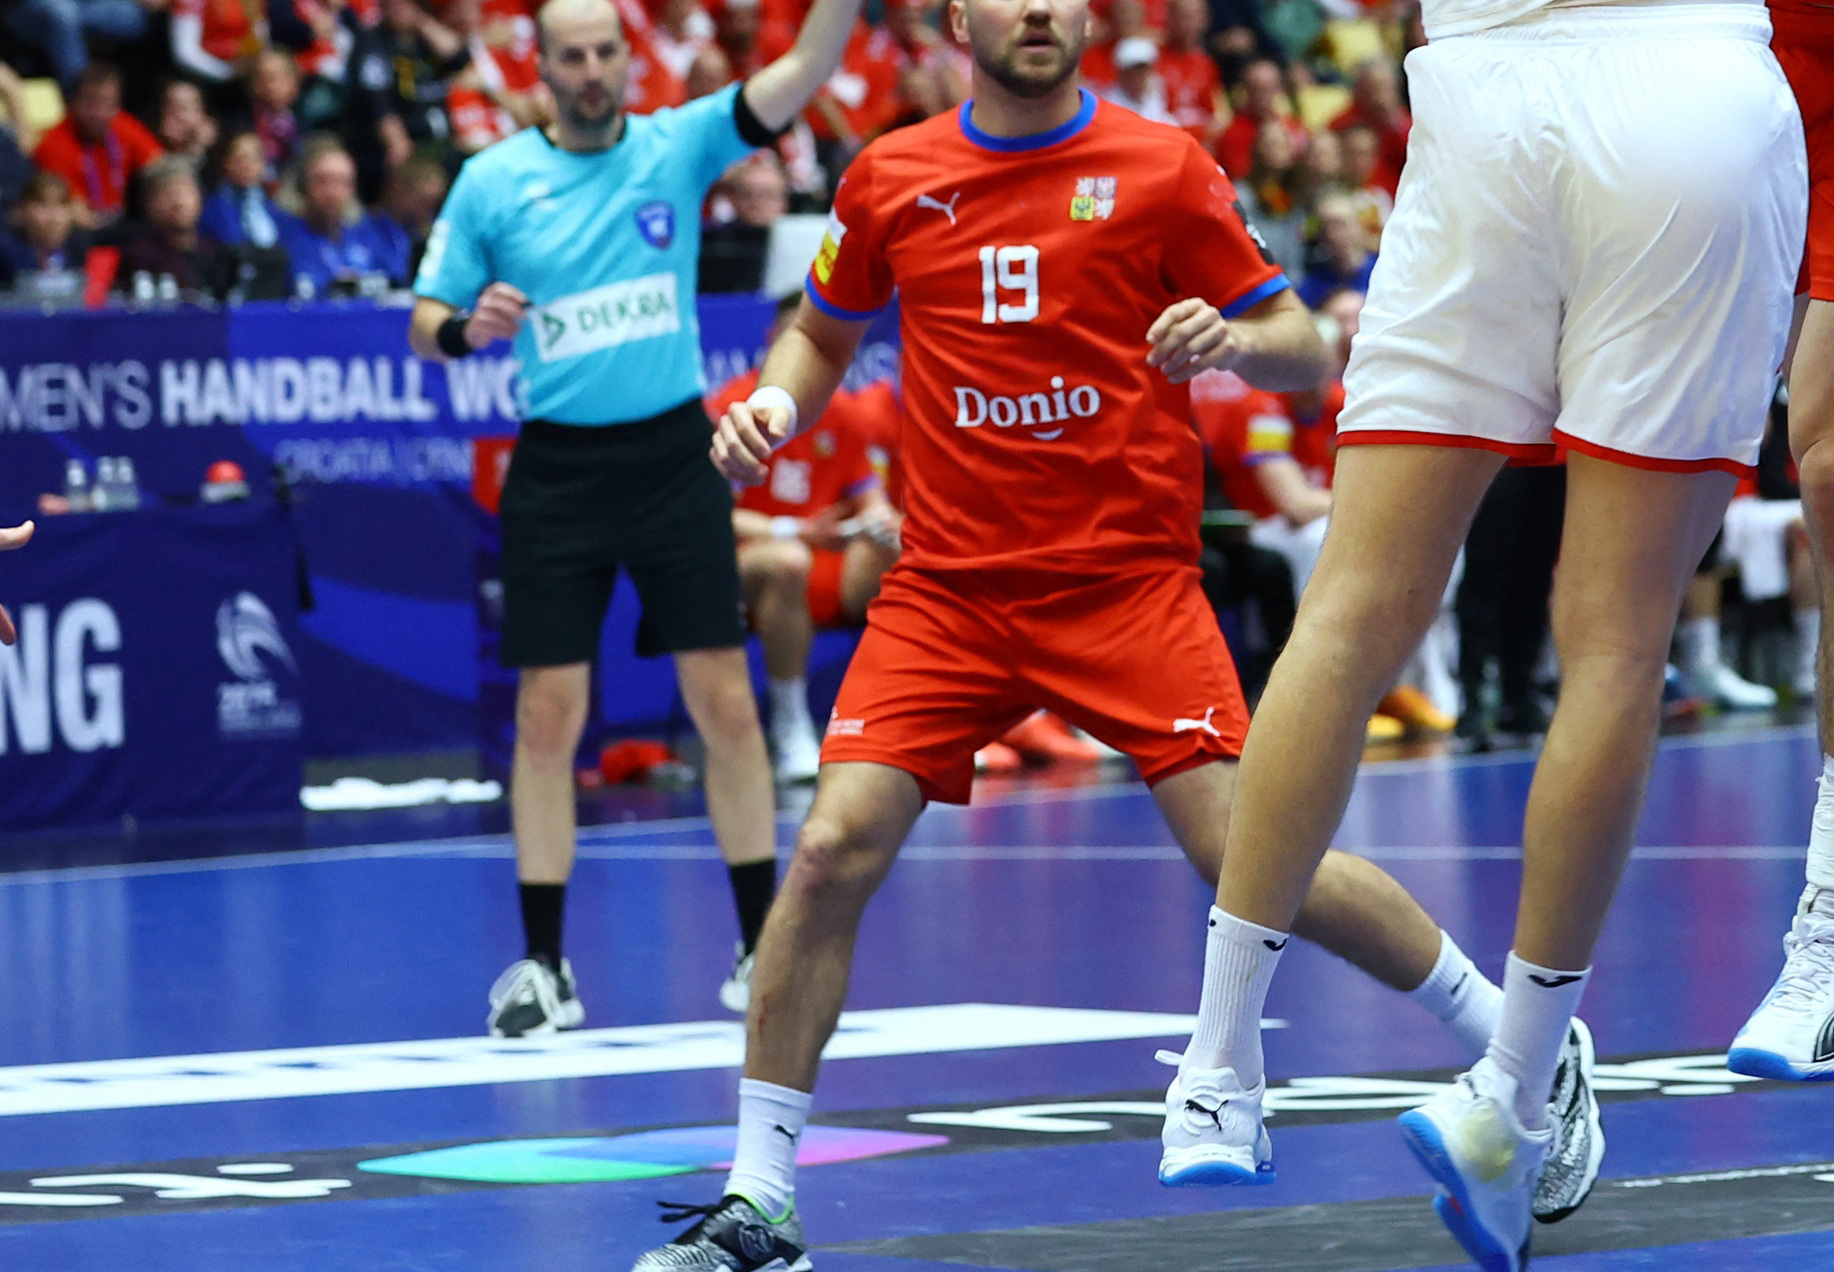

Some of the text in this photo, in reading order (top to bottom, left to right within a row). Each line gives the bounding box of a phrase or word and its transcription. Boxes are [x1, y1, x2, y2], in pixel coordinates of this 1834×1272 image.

[576, 288, 672, 334] DEKRA
[979, 245, 1040, 324] 19
[160, 357, 437, 427] HANDBALL
[954, 376, 1101, 428] Donio
